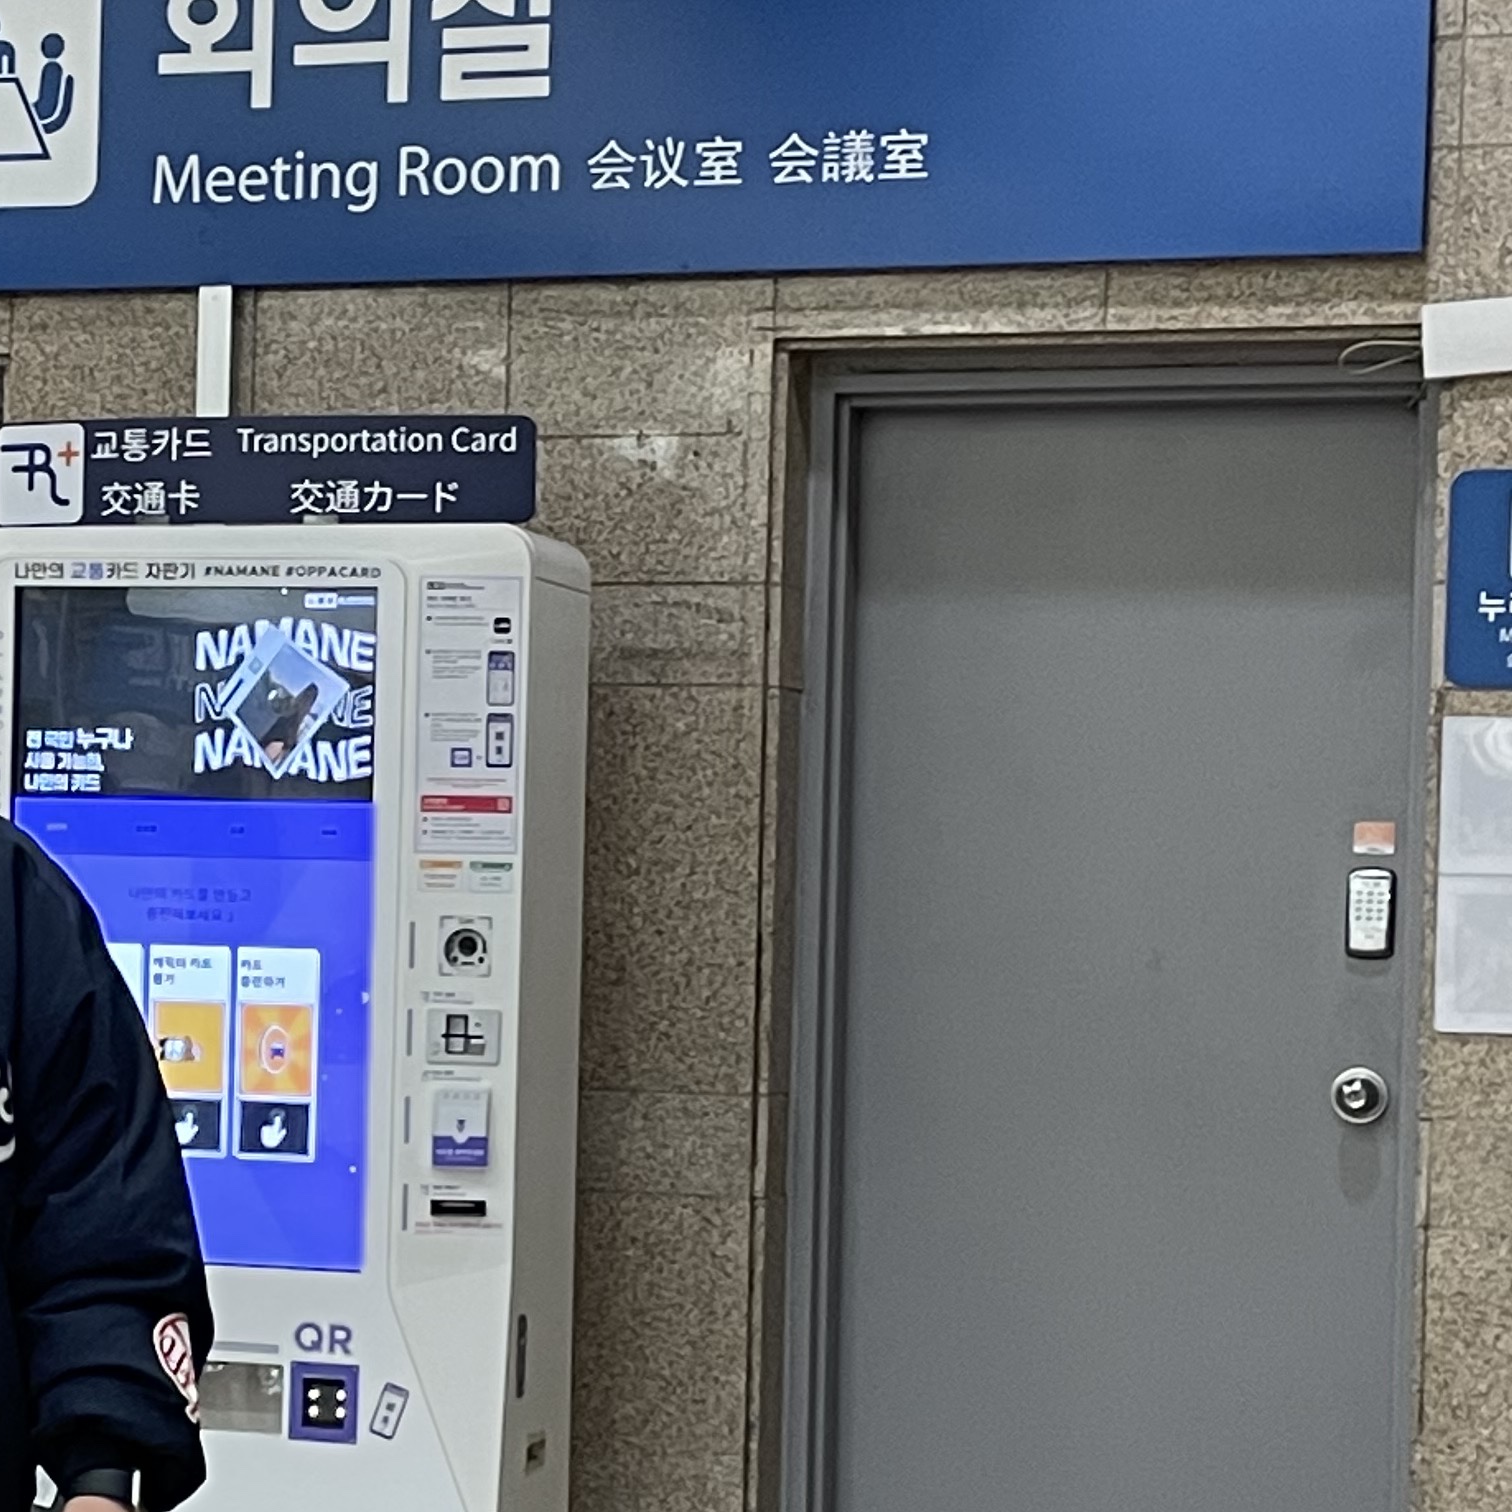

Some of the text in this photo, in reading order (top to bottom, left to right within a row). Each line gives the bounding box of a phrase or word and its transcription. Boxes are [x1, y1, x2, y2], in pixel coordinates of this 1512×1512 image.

[157, 0, 551, 109] 회의실
[152, 128, 930, 213] Meeting Room 会议室 会議室
[90, 428, 213, 461] 교통카드
[237, 427, 518, 458] Transportation Card
[100, 481, 202, 516] 交通卡
[289, 479, 459, 515] 交通カード
[14, 561, 64, 580] 나만의
[70, 561, 140, 580] 교통카드
[144, 562, 196, 580] 자판기
[204, 565, 281, 577] #NAMANE
[75, 727, 134, 750] 누구나
[193, 727, 373, 782] NAANE
[294, 1321, 354, 1355] QR
